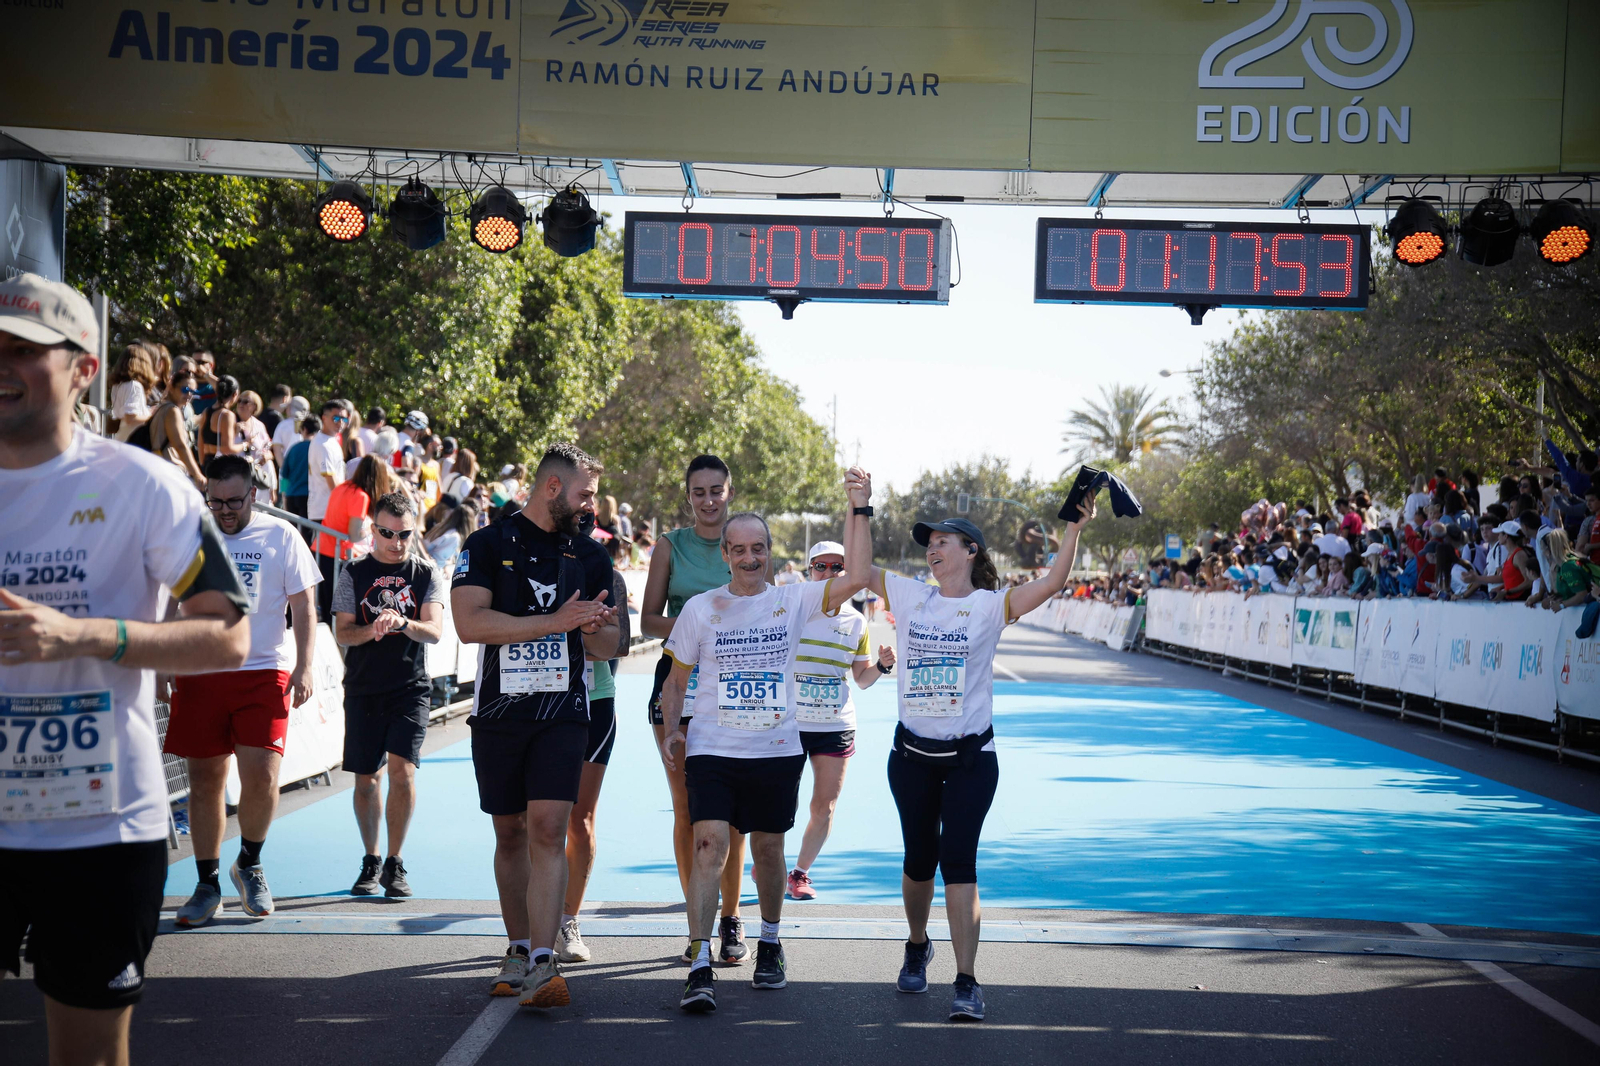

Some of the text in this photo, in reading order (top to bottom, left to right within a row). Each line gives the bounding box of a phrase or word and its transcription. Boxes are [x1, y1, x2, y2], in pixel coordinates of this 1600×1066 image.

[640, 20, 722, 36] SERIES
[108, 9, 512, 81] Almería 2024
[632, 35, 768, 51] RUTA RUNNING
[545, 57, 941, 97] RAMÓN RUIZ ANDÚJAR
[1196, 95, 1412, 144] EDICIÓN
[4, 547, 87, 566] Maratón
[25, 564, 87, 586] 2024
[714, 634, 760, 647] Almería
[715, 628, 745, 638] Medio
[940, 633, 969, 643] 2024
[507, 642, 562, 662] 5388
[714, 646, 740, 655] RAMÓN
[910, 666, 959, 687] 5050
[725, 681, 778, 700] 5051
[798, 683, 840, 700] 5033
[933, 684, 957, 692] CARMEN
[12, 753, 65, 765] LA SUSY
